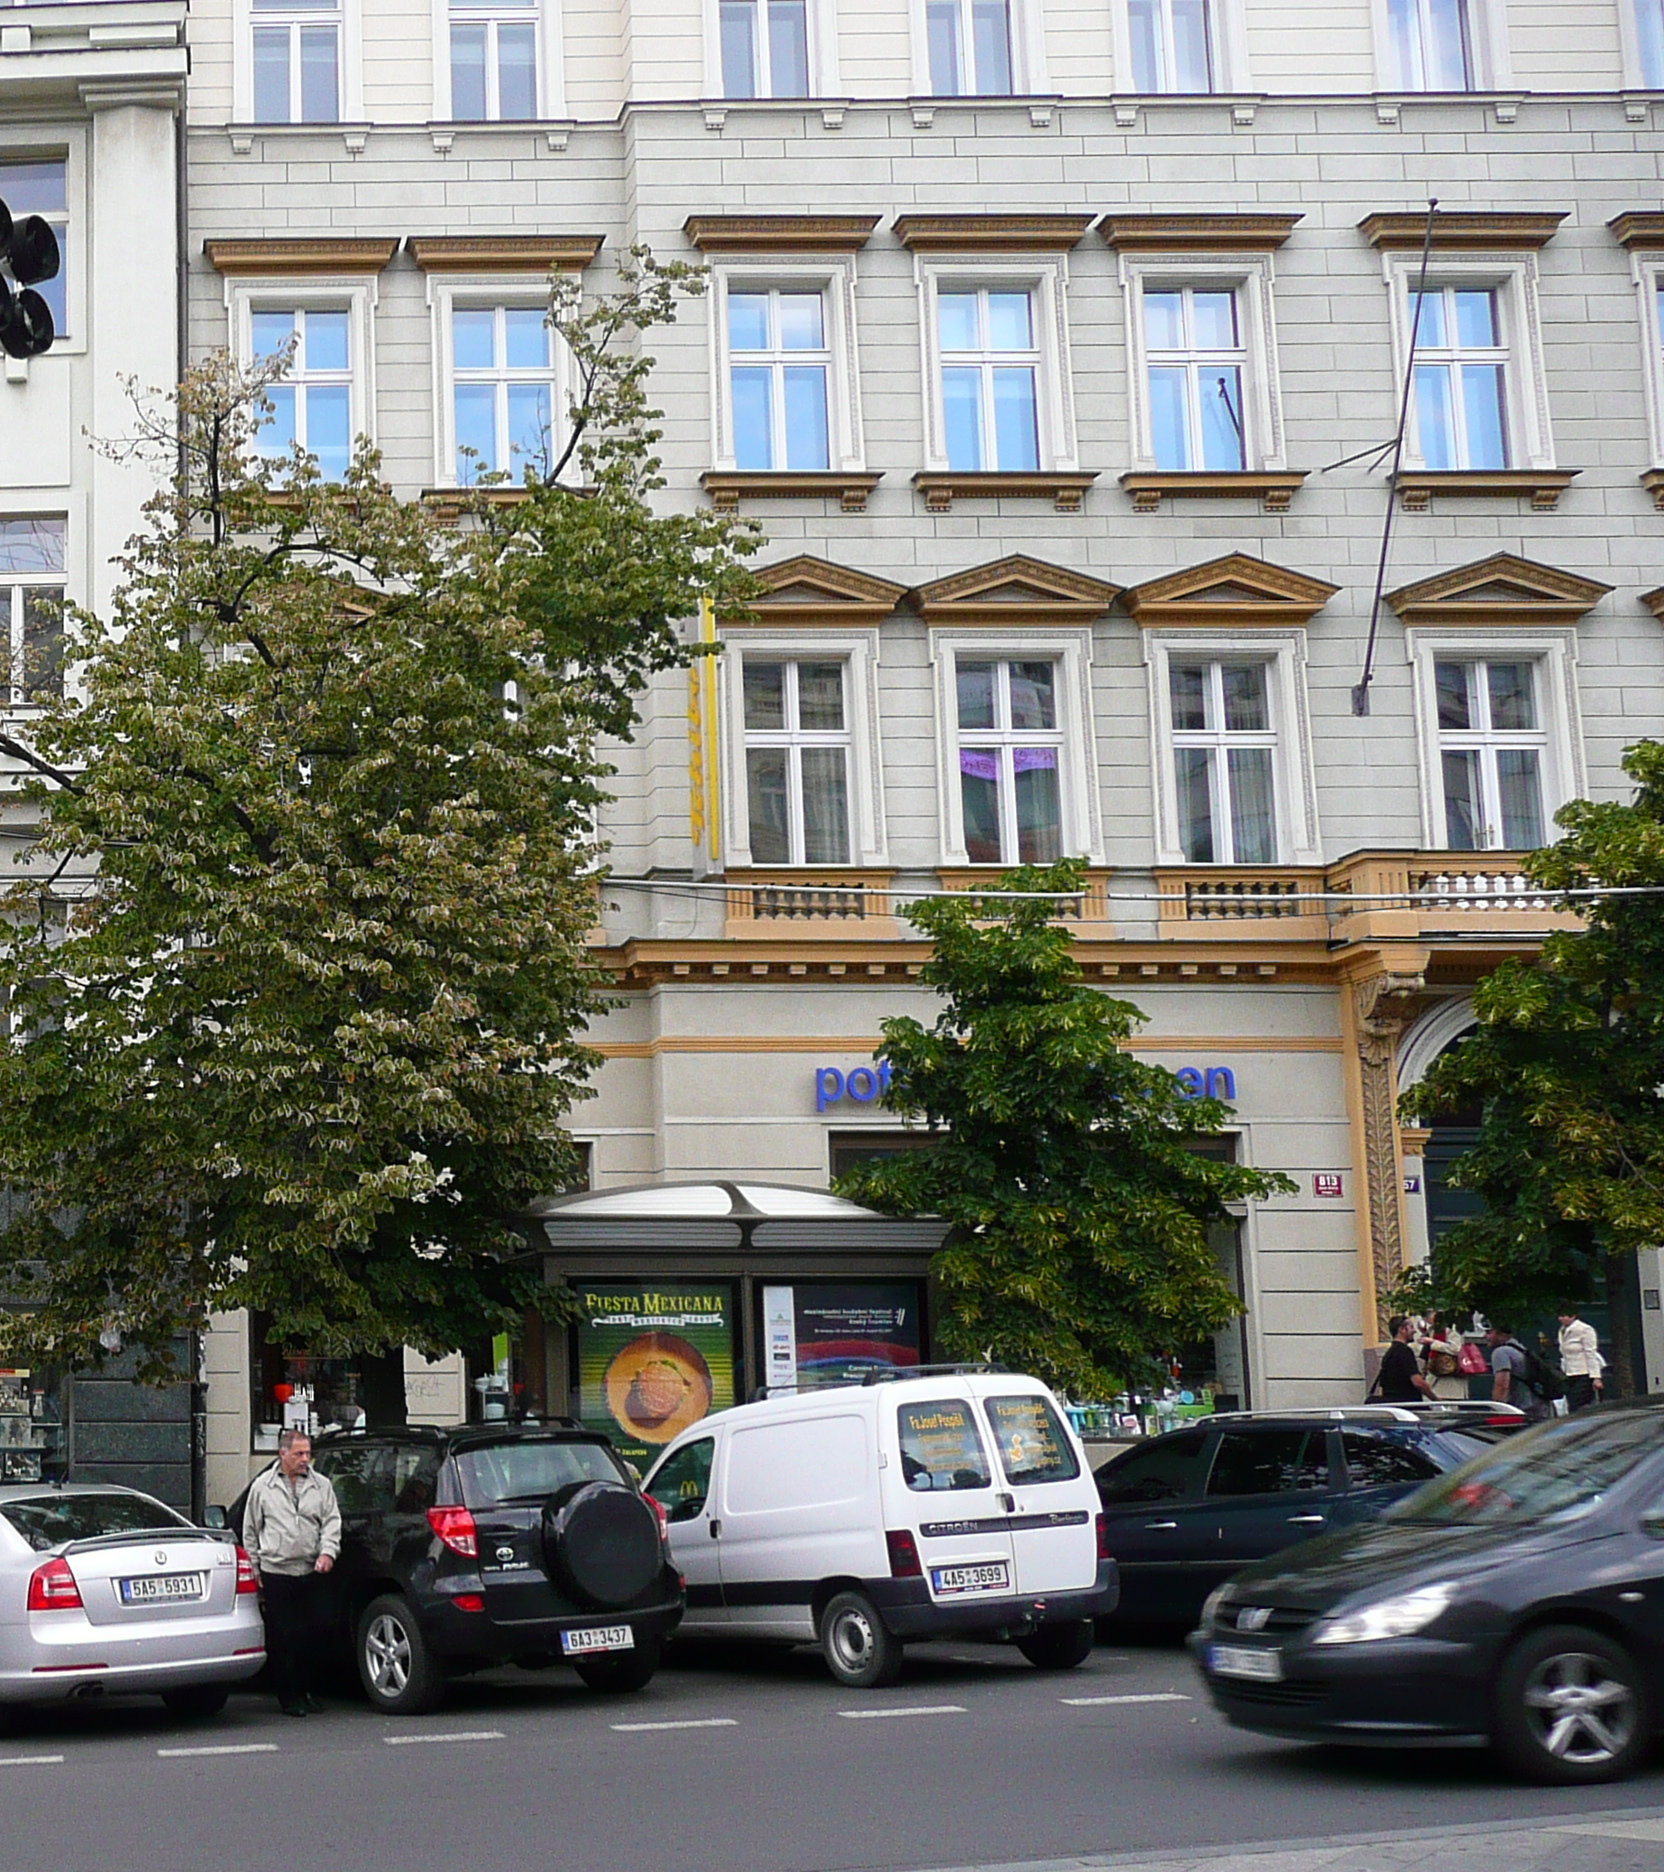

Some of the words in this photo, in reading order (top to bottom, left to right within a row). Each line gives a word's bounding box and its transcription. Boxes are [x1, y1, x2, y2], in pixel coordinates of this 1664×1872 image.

[1318, 1176, 1338, 1186] 813
[585, 1293, 640, 1312] FIESTA
[643, 1293, 724, 1315] MEXICANA
[944, 1570, 965, 1586] 4A5
[973, 1567, 1001, 1583] 3699
[133, 1581, 157, 1596] 5A5
[164, 1577, 195, 1594] 5931
[570, 1632, 592, 1647] 6A3
[600, 1628, 626, 1644] 3437
